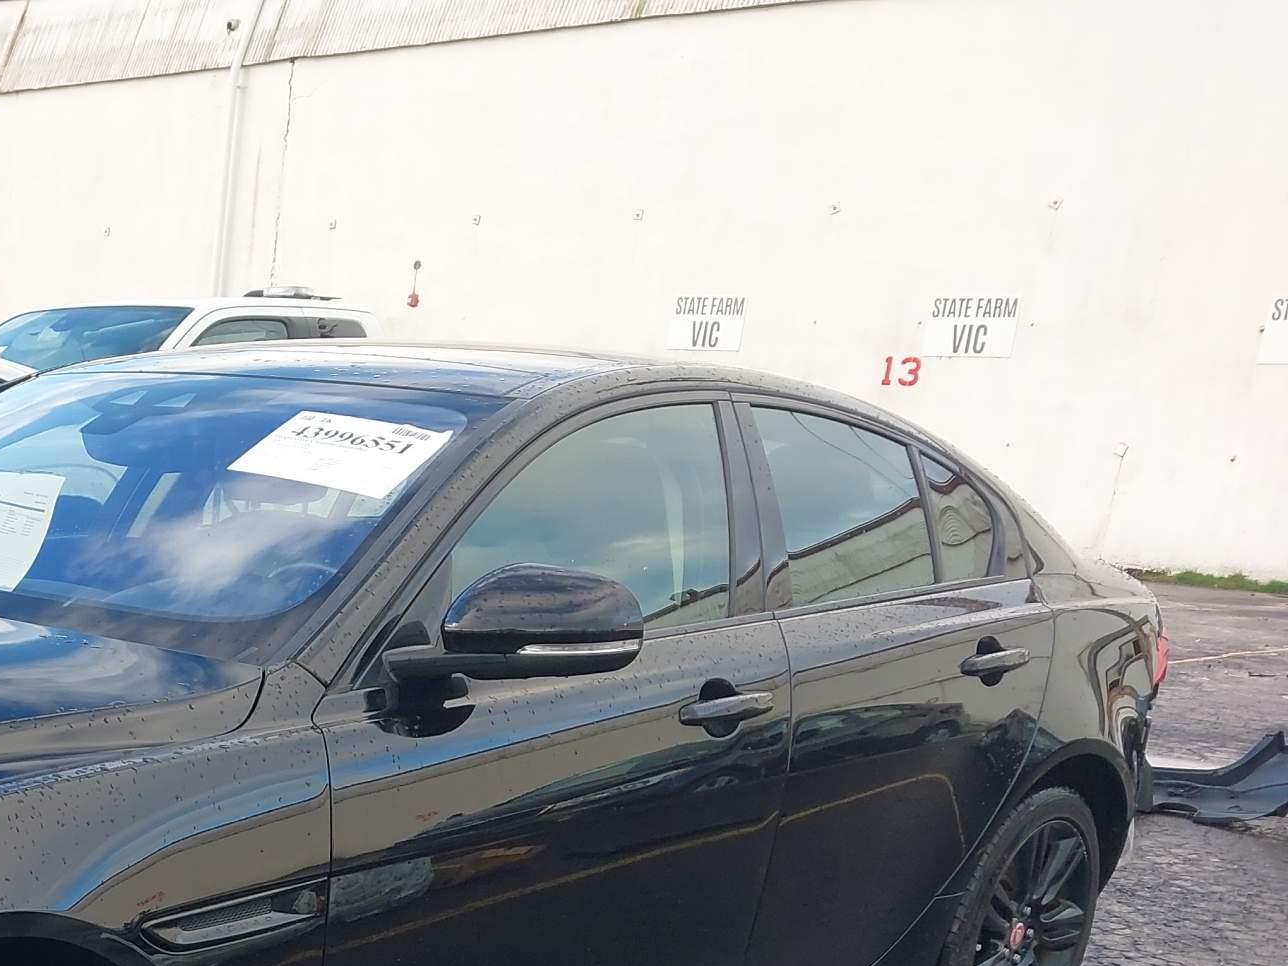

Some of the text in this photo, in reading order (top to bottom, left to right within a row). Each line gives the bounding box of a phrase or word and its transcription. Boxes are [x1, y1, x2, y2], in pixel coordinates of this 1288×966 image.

[675, 296, 745, 316] STATE FARM
[932, 297, 1019, 319] STATE FARM
[692, 320, 720, 348] VIC
[952, 323, 988, 354] VIC
[881, 356, 922, 387] 13
[291, 424, 414, 455] 43996551
